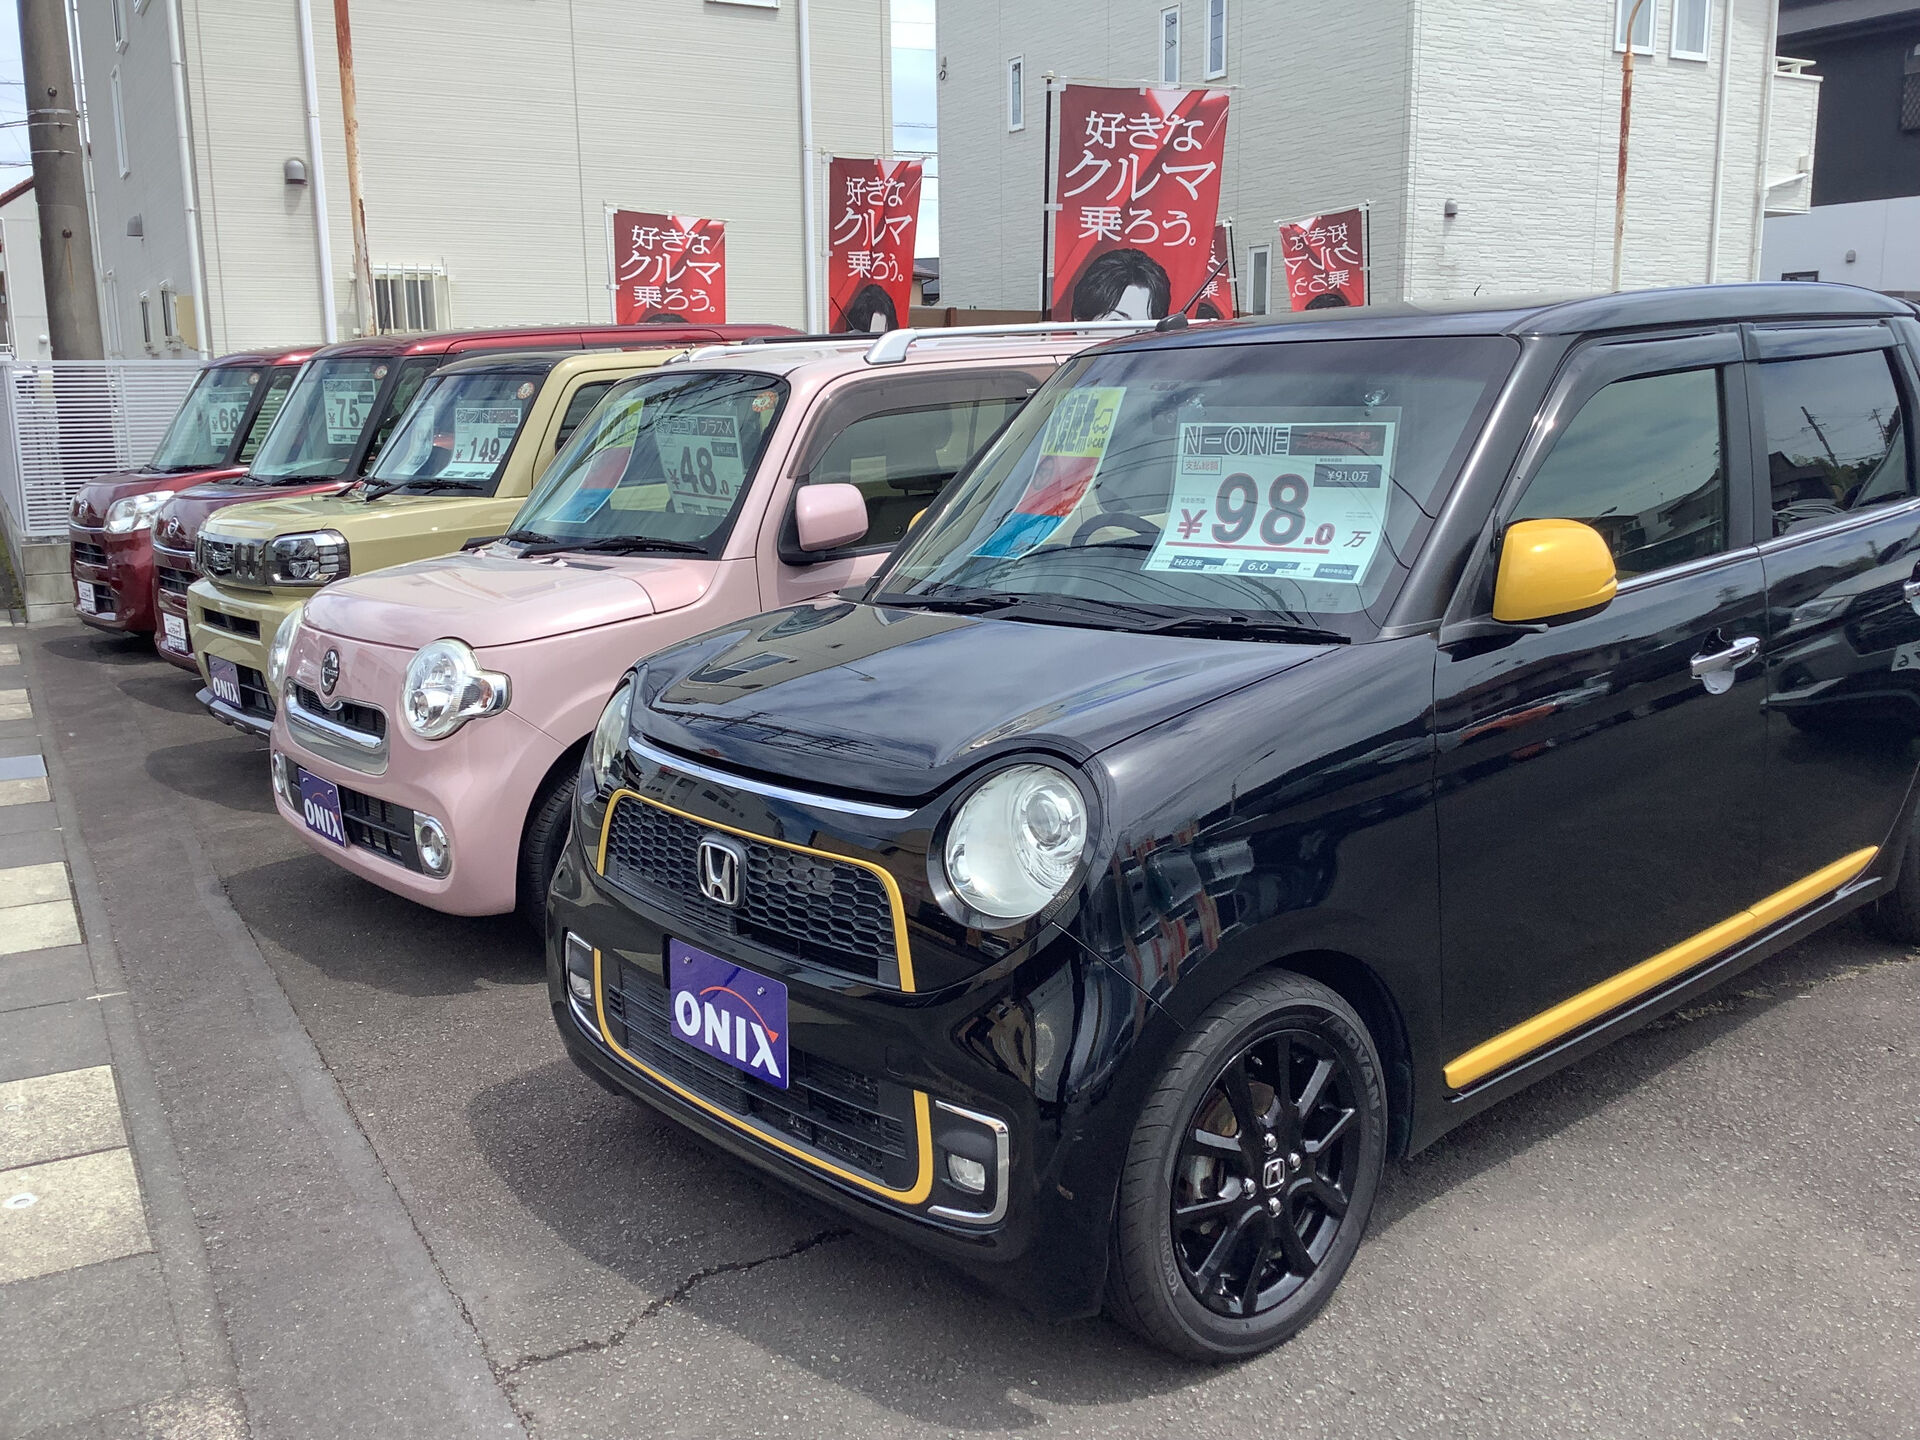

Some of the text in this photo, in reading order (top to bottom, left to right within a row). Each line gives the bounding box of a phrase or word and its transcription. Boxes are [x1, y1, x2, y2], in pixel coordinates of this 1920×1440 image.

[1085, 110, 1204, 152] 好きな
[1063, 149, 1217, 202] クルマ
[845, 176, 906, 208] 好きな
[631, 224, 711, 255] 好きな
[833, 207, 913, 248] クルマ
[1078, 205, 1198, 248] 乗ろう。
[620, 250, 722, 285] クルマ
[847, 250, 904, 282] 乗ろう。
[633, 286, 716, 313] 乗ろう。
[701, 419, 733, 436] プラスX
[1183, 424, 1290, 456] N-ONE
[1247, 562, 1269, 572] 6.0
[212, 676, 240, 704] ONIX
[304, 798, 344, 842] ONIX
[674, 990, 782, 1079] ONIX
